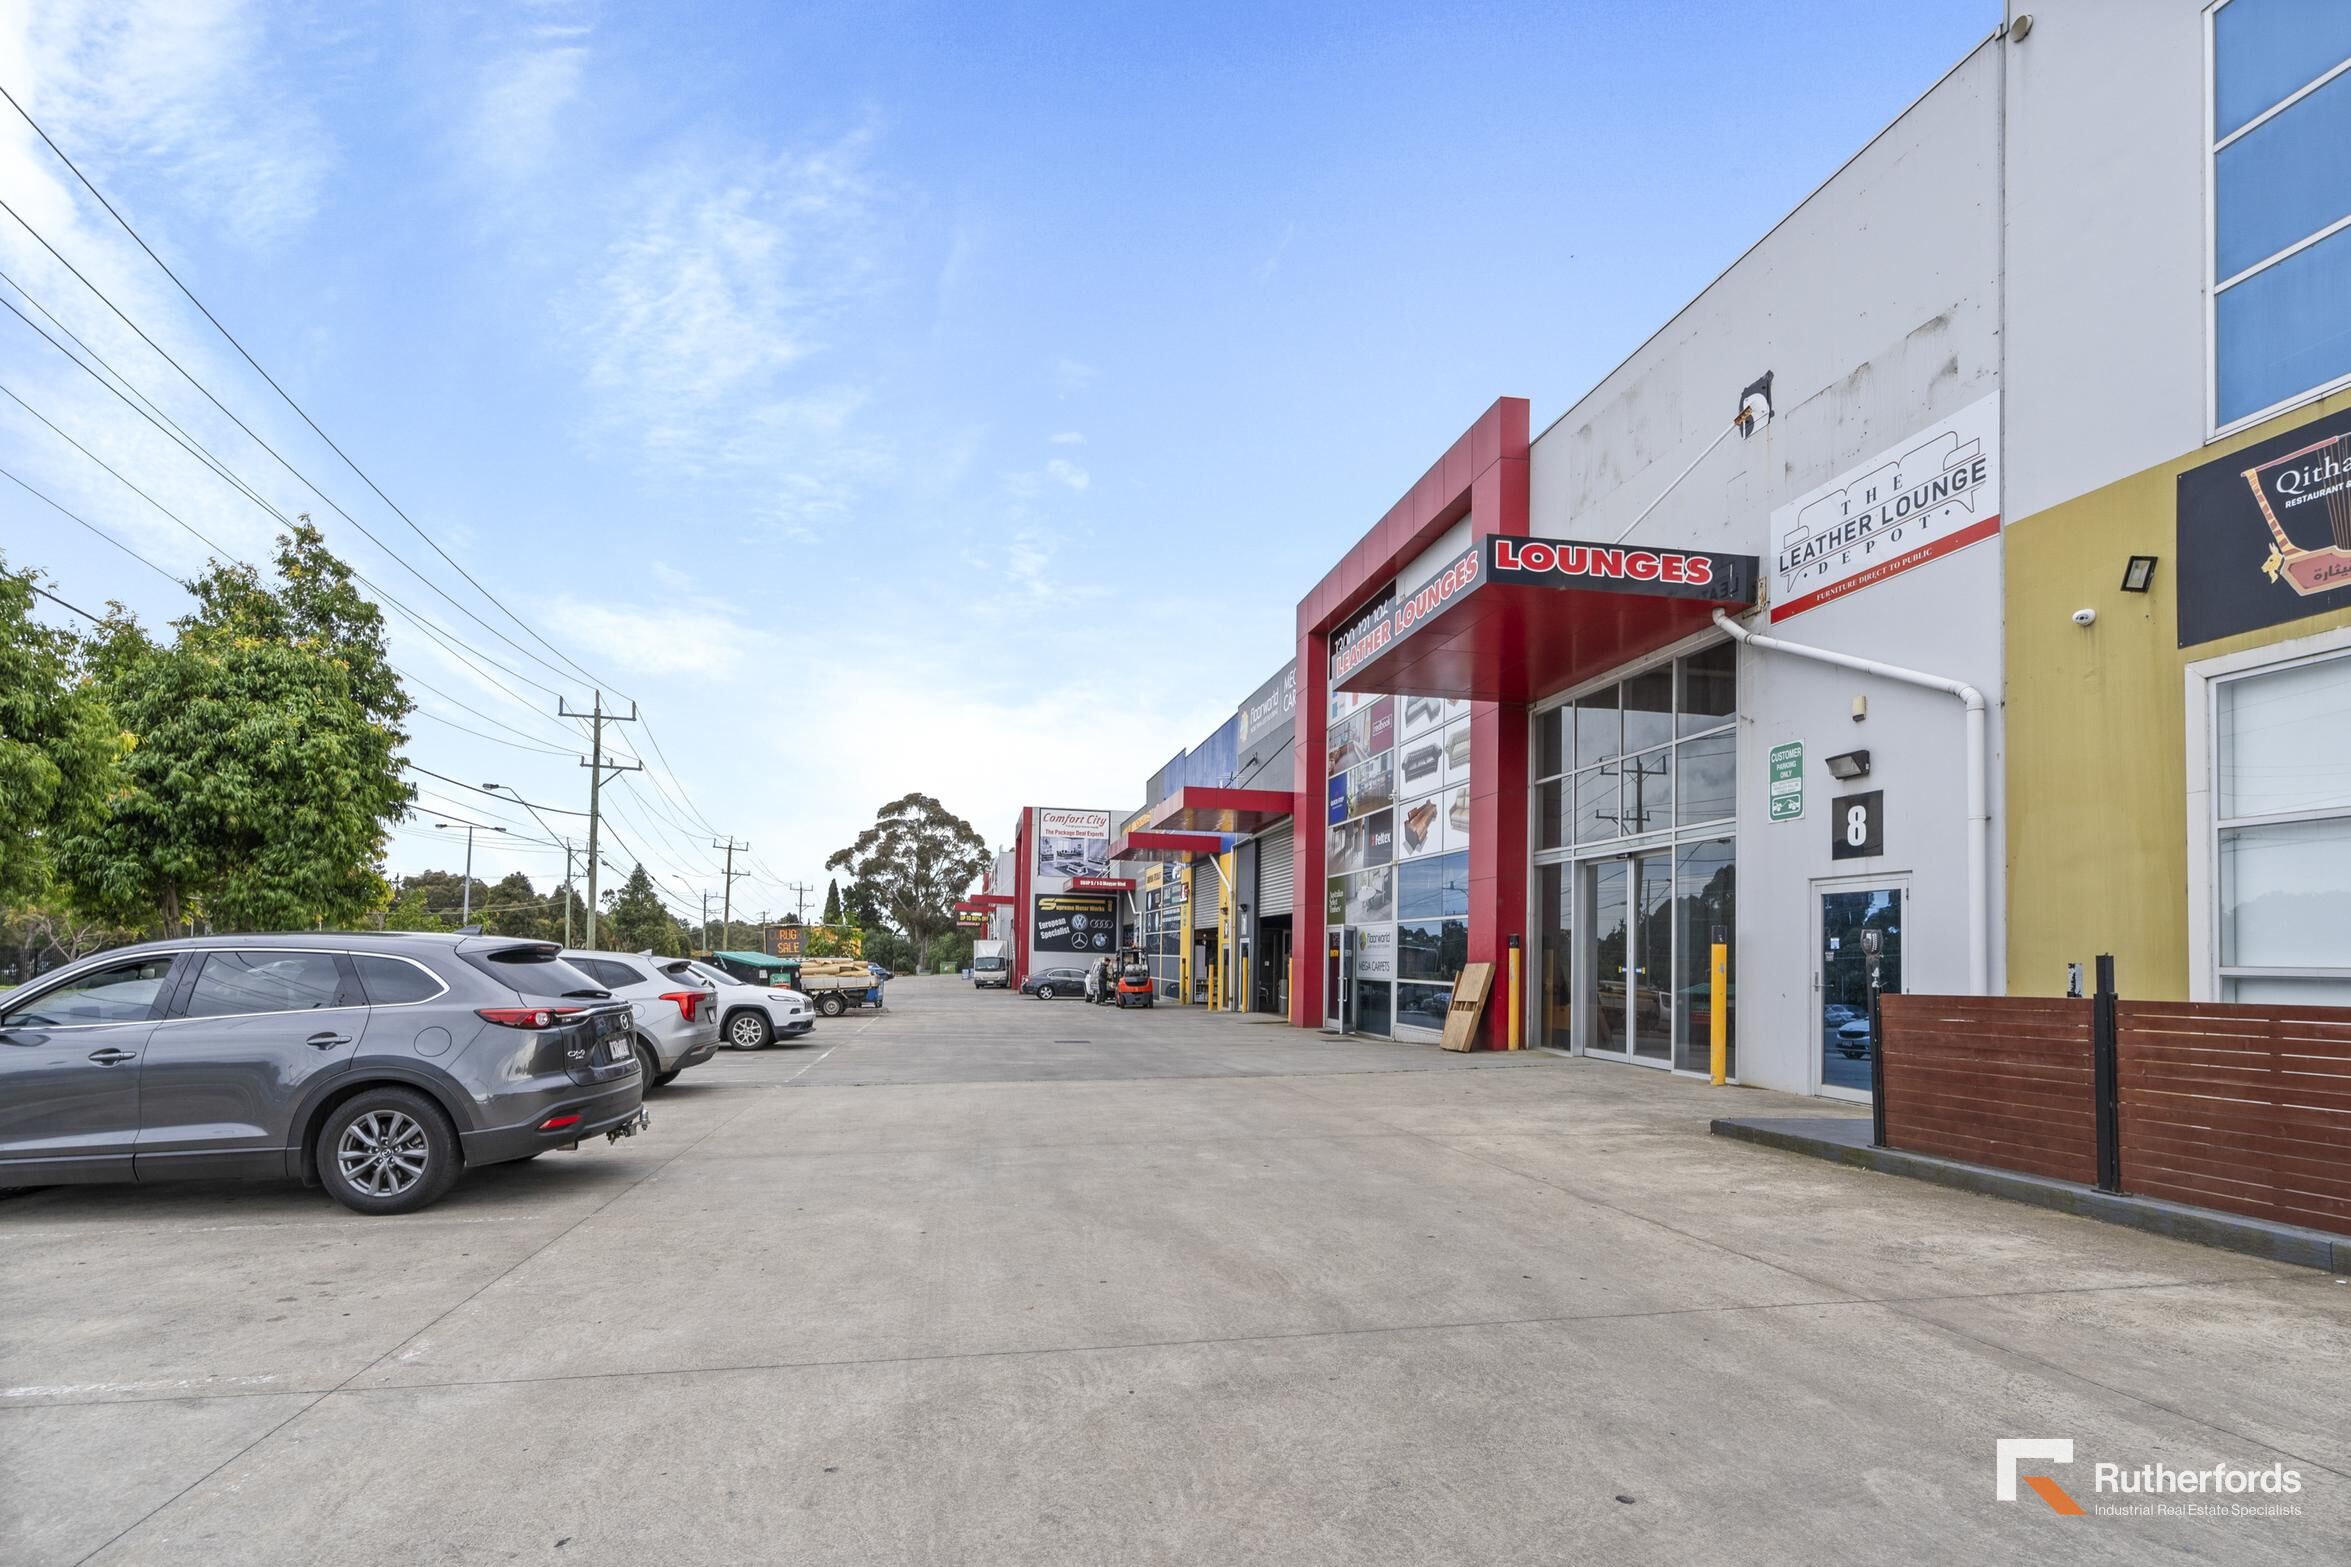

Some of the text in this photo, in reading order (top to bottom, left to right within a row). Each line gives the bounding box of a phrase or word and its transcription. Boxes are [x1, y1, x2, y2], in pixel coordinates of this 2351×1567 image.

[1841, 474, 1902, 515] THE
[2285, 483, 2344, 509] RESTAURANT
[1779, 458, 1986, 572] LEATHER LOUNGE
[1819, 515, 1930, 575] DEPOT
[1495, 540, 1712, 586] LOUNGES
[1817, 548, 1932, 601] FURNITURE DIRECT TO PUBLIC
[1336, 550, 1478, 679] LEATHER LOUNGES
[1771, 747, 1801, 763] CUSTOMER
[1776, 760, 1796, 771] PARKING
[1780, 769, 1792, 779] ONLY
[1043, 812, 1106, 827] Comfort City
[1847, 805, 1866, 846] 8
[1038, 917, 1066, 929] European
[1040, 926, 1070, 939] Specialist
[780, 929, 796, 940] RUG
[777, 942, 800, 953] SALE
